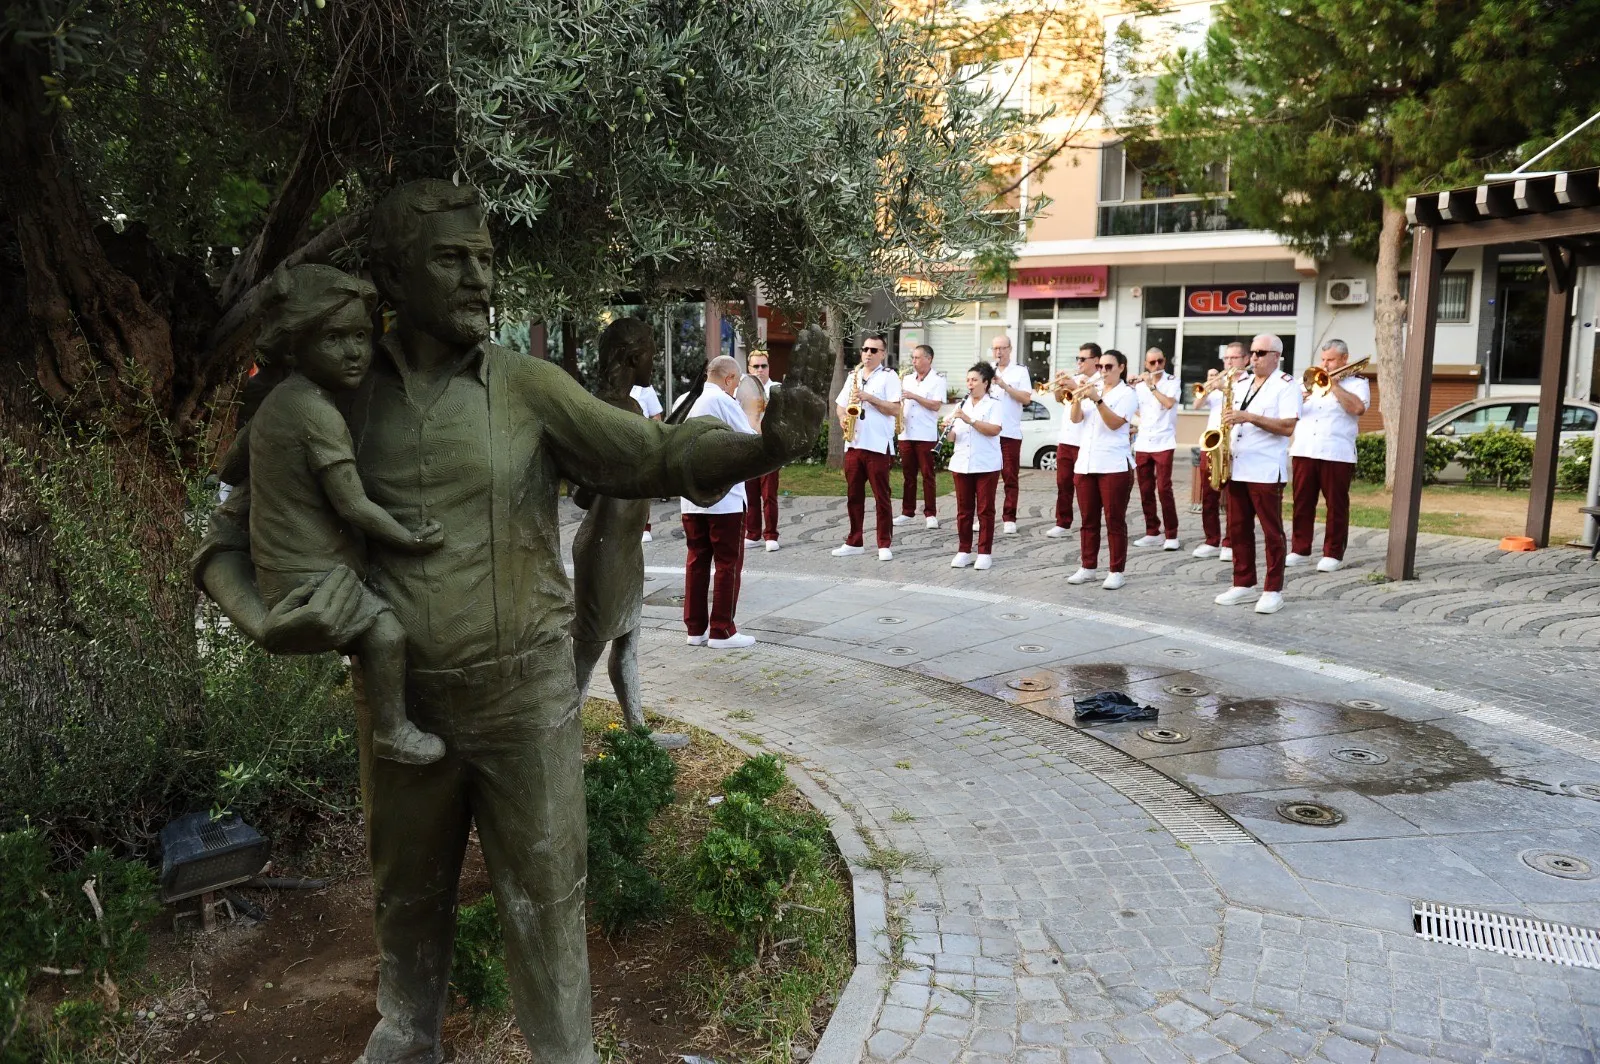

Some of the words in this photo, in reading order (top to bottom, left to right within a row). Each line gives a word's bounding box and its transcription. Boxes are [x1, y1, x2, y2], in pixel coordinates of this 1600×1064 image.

[1249, 291, 1267, 301] Cam
[1268, 291, 1295, 301] Balkon
[1188, 290, 1247, 313] GLC
[1248, 303, 1294, 312] Sistemleri
